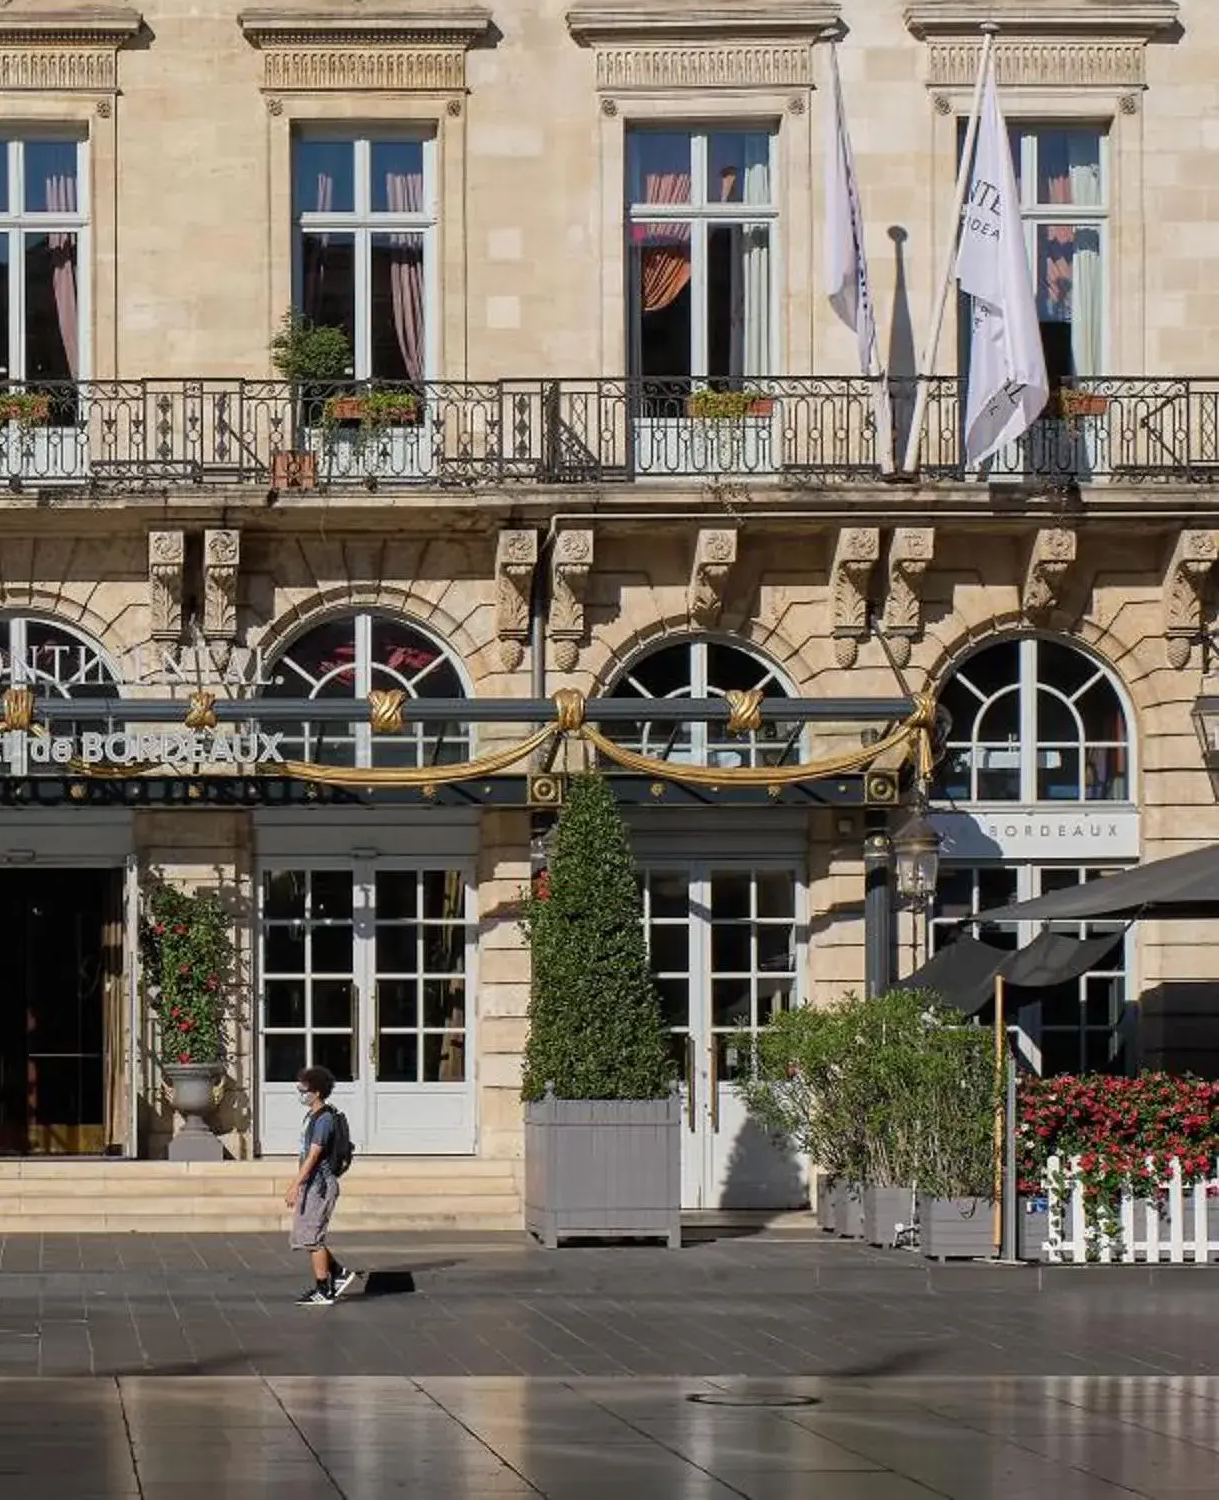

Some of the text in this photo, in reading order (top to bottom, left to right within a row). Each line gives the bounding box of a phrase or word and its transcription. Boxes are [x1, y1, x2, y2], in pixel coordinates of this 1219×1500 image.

[30, 731, 74, 763] de
[82, 731, 285, 764] BORDEAUX
[988, 823, 1119, 838] BORDEAUX
